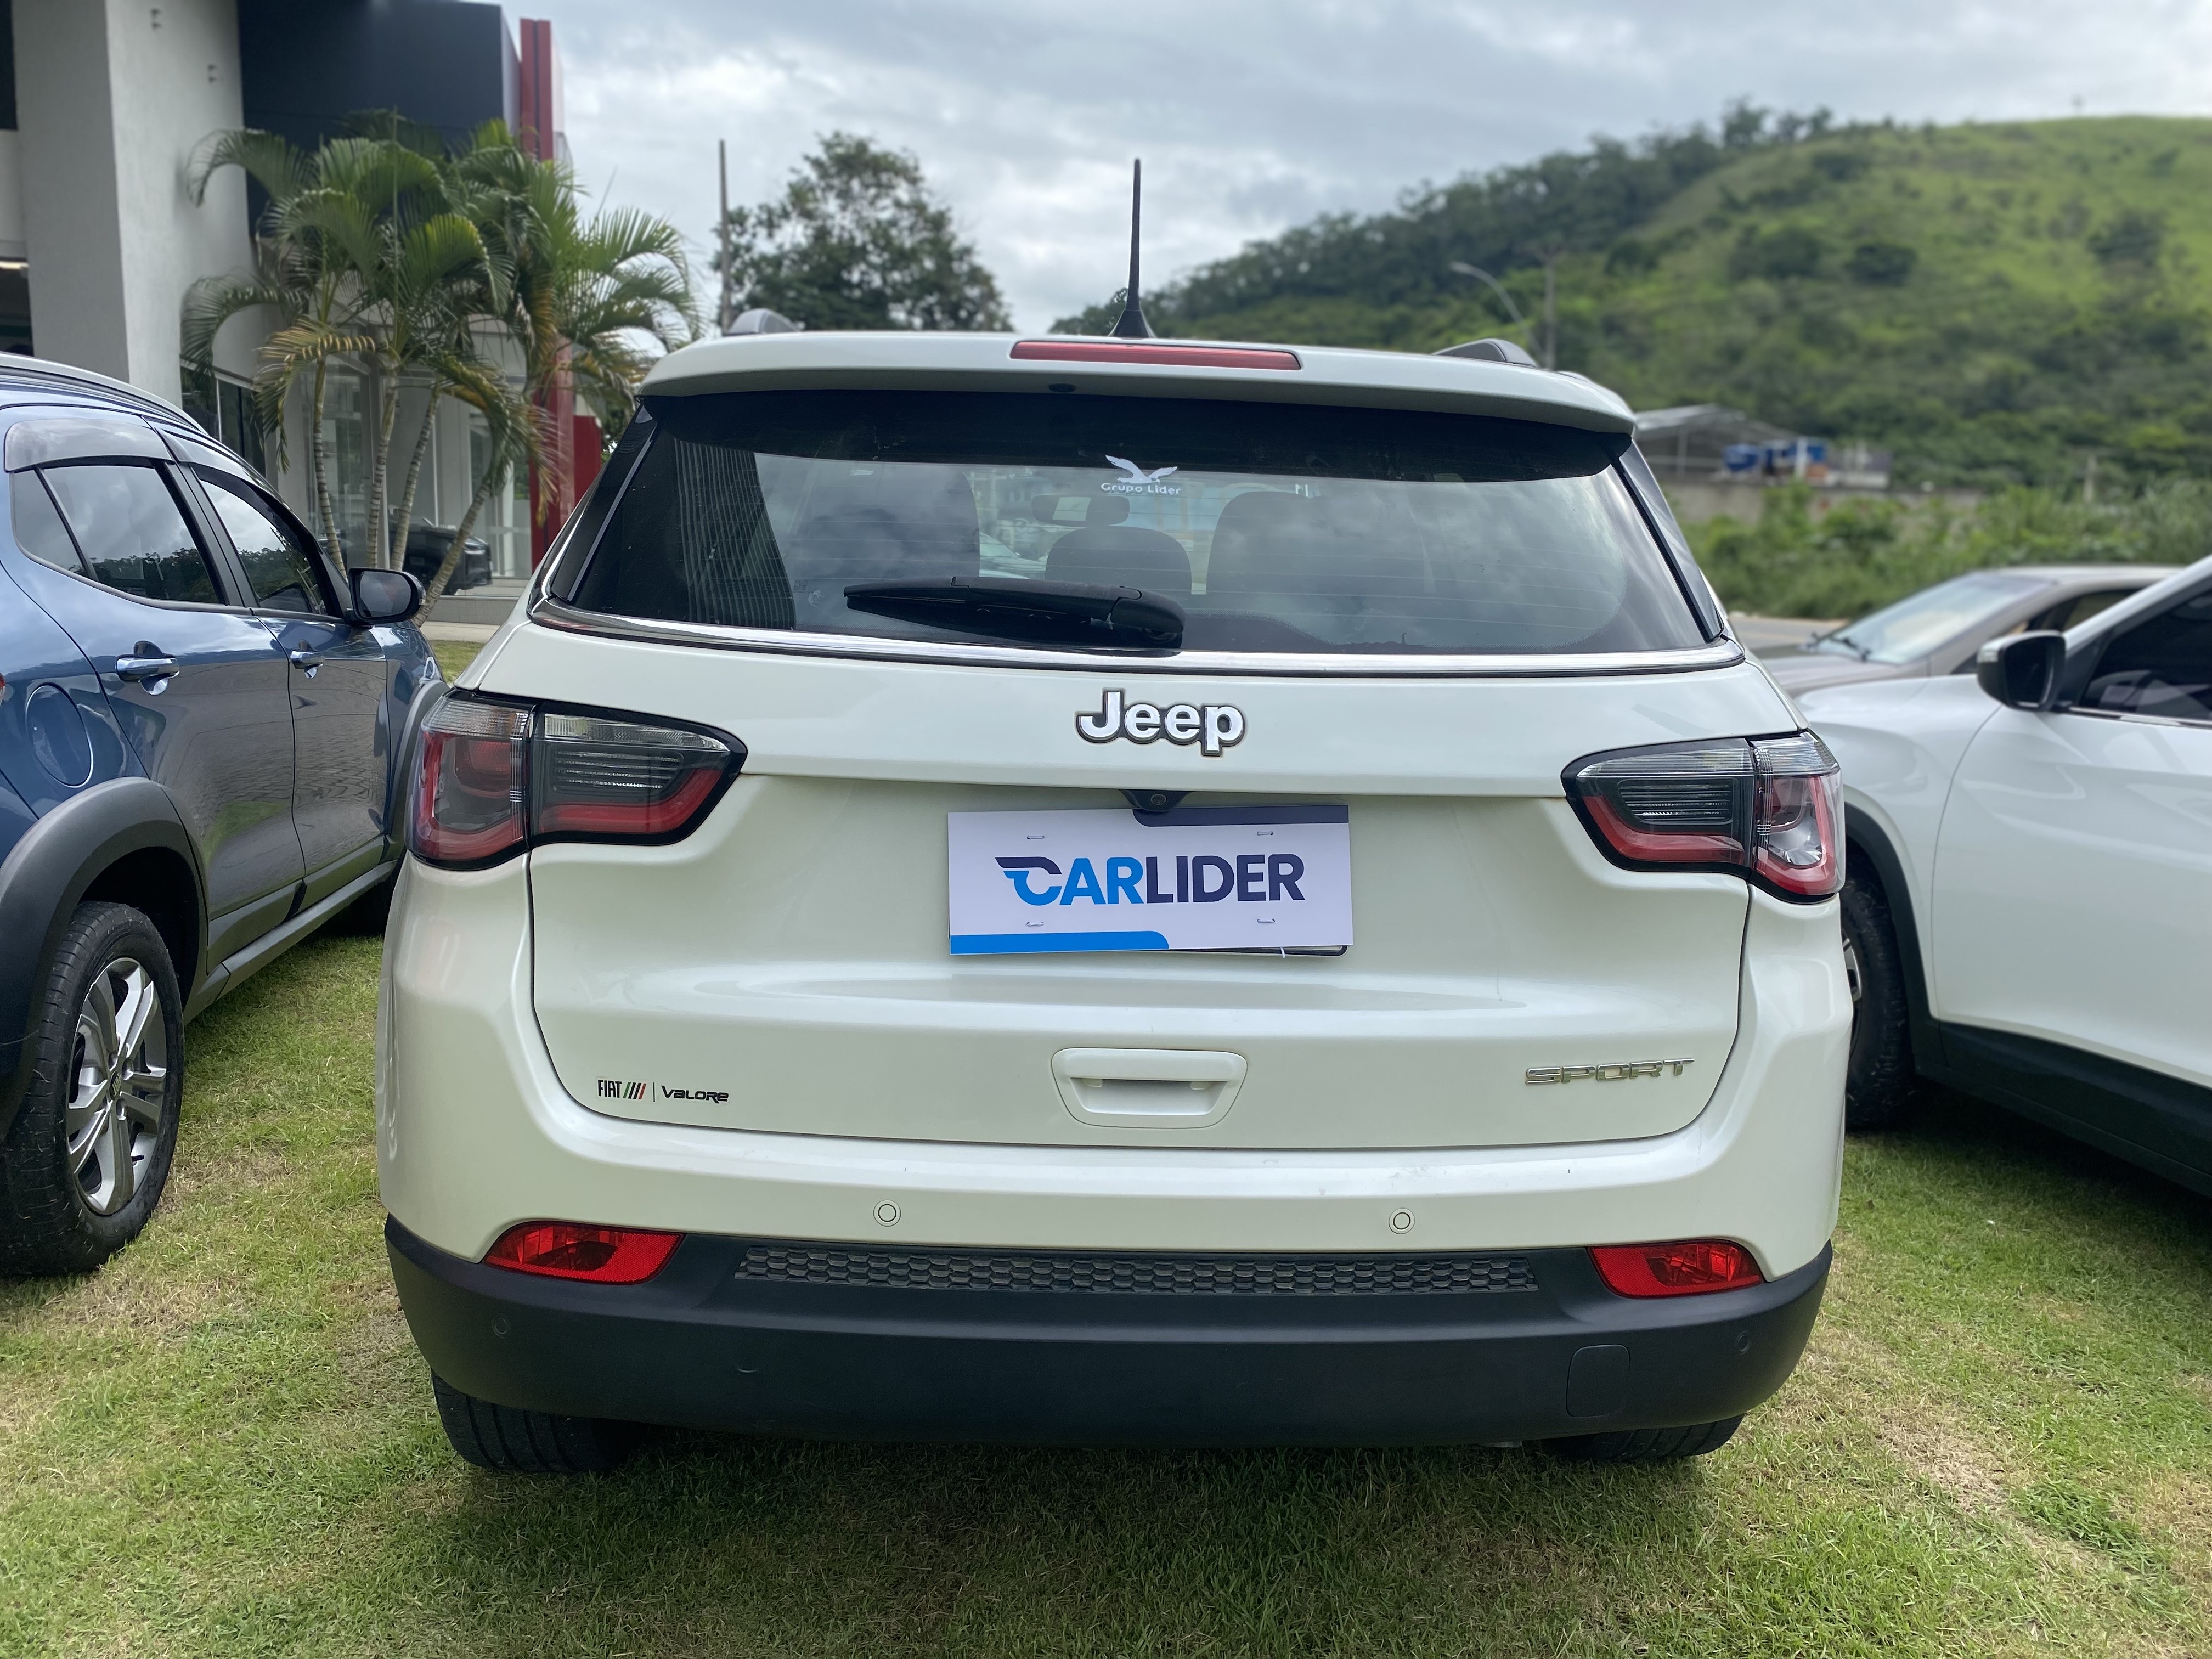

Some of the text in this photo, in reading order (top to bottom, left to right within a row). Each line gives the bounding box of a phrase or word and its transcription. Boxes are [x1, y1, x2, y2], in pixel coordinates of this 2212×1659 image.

[1101, 482, 1143, 494] Grupo
[1076, 689, 1245, 757] Jeep
[995, 854, 1305, 906] CARLIDER
[1525, 1057, 1695, 1085] SPORT
[597, 1079, 622, 1098] FIAT
